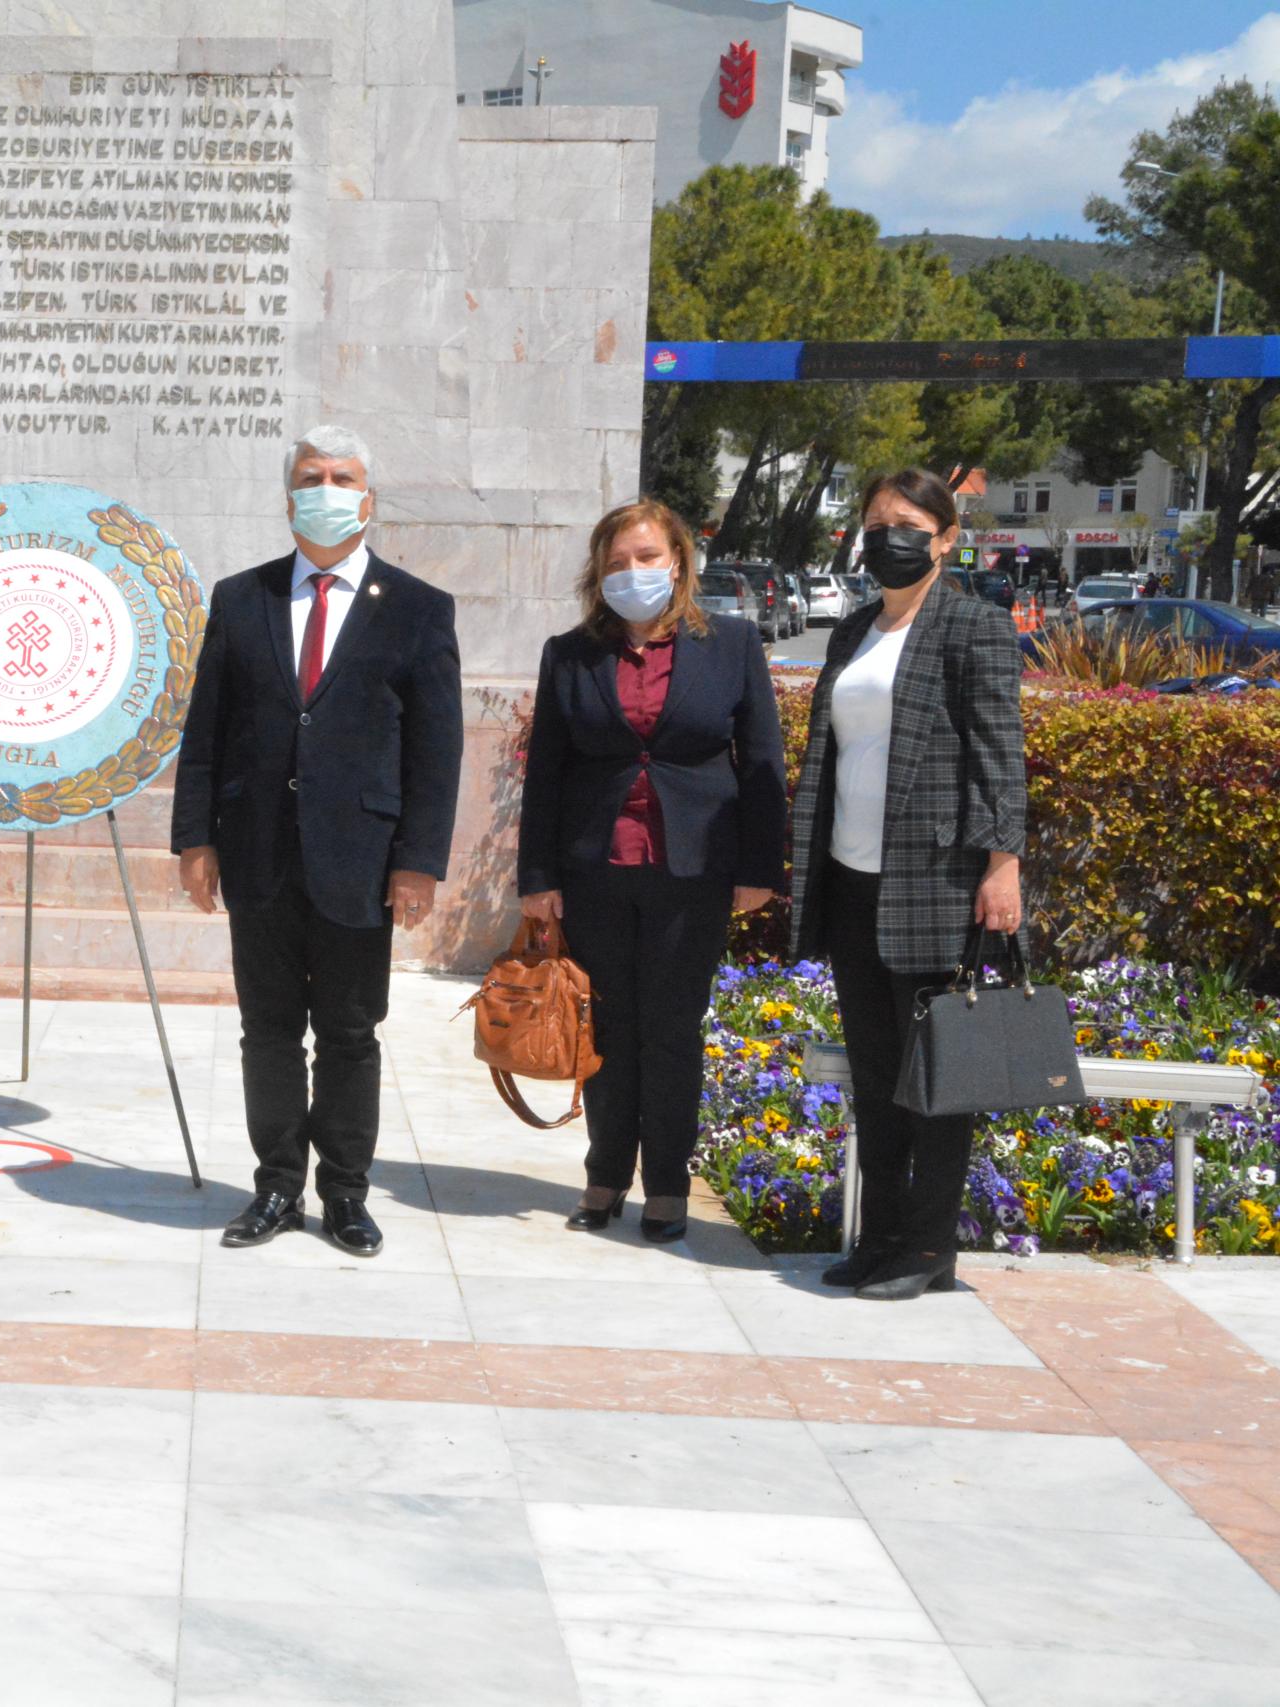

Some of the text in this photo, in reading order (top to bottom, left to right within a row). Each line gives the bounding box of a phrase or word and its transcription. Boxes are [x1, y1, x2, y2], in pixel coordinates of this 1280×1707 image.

[10, 257, 65, 282] TÜRK
[81, 289, 137, 313] TÜRK
[259, 295, 287, 316] VE
[72, 351, 177, 375] OLDUĞUN
[209, 385, 283, 407] KANDA
[176, 414, 283, 438] ATATÜRK
[1075, 532, 1120, 543] BOSCH
[56, 602, 69, 614] VE
